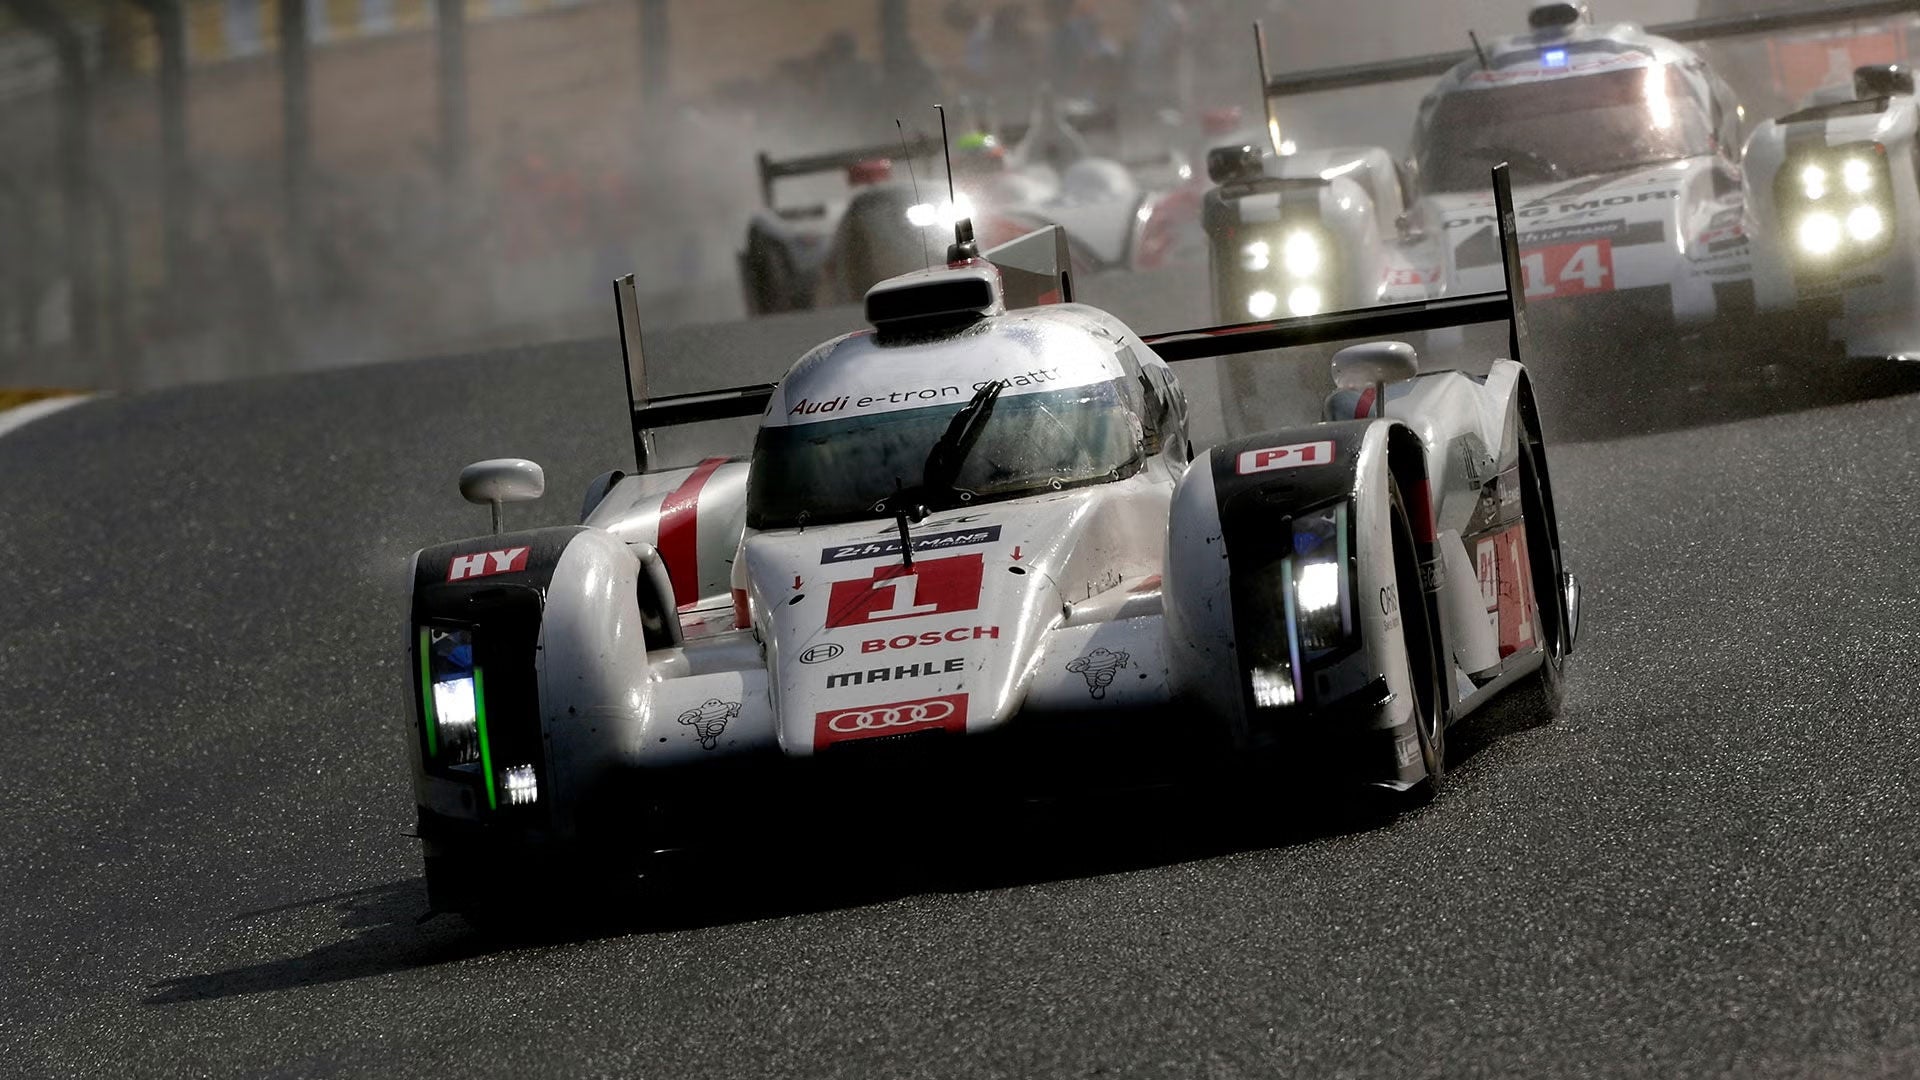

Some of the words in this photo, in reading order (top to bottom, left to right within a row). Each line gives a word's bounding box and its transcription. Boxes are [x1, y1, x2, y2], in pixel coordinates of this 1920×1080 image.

[1520, 245, 1609, 296] 14
[789, 396, 851, 415] Audi
[856, 385, 960, 408] e-tron
[1255, 446, 1316, 468] P1
[918, 531, 990, 548] MANS
[450, 547, 527, 580] HY
[867, 574, 938, 620] 1
[861, 626, 999, 654] BOSCH
[826, 657, 965, 688] MAHLE
